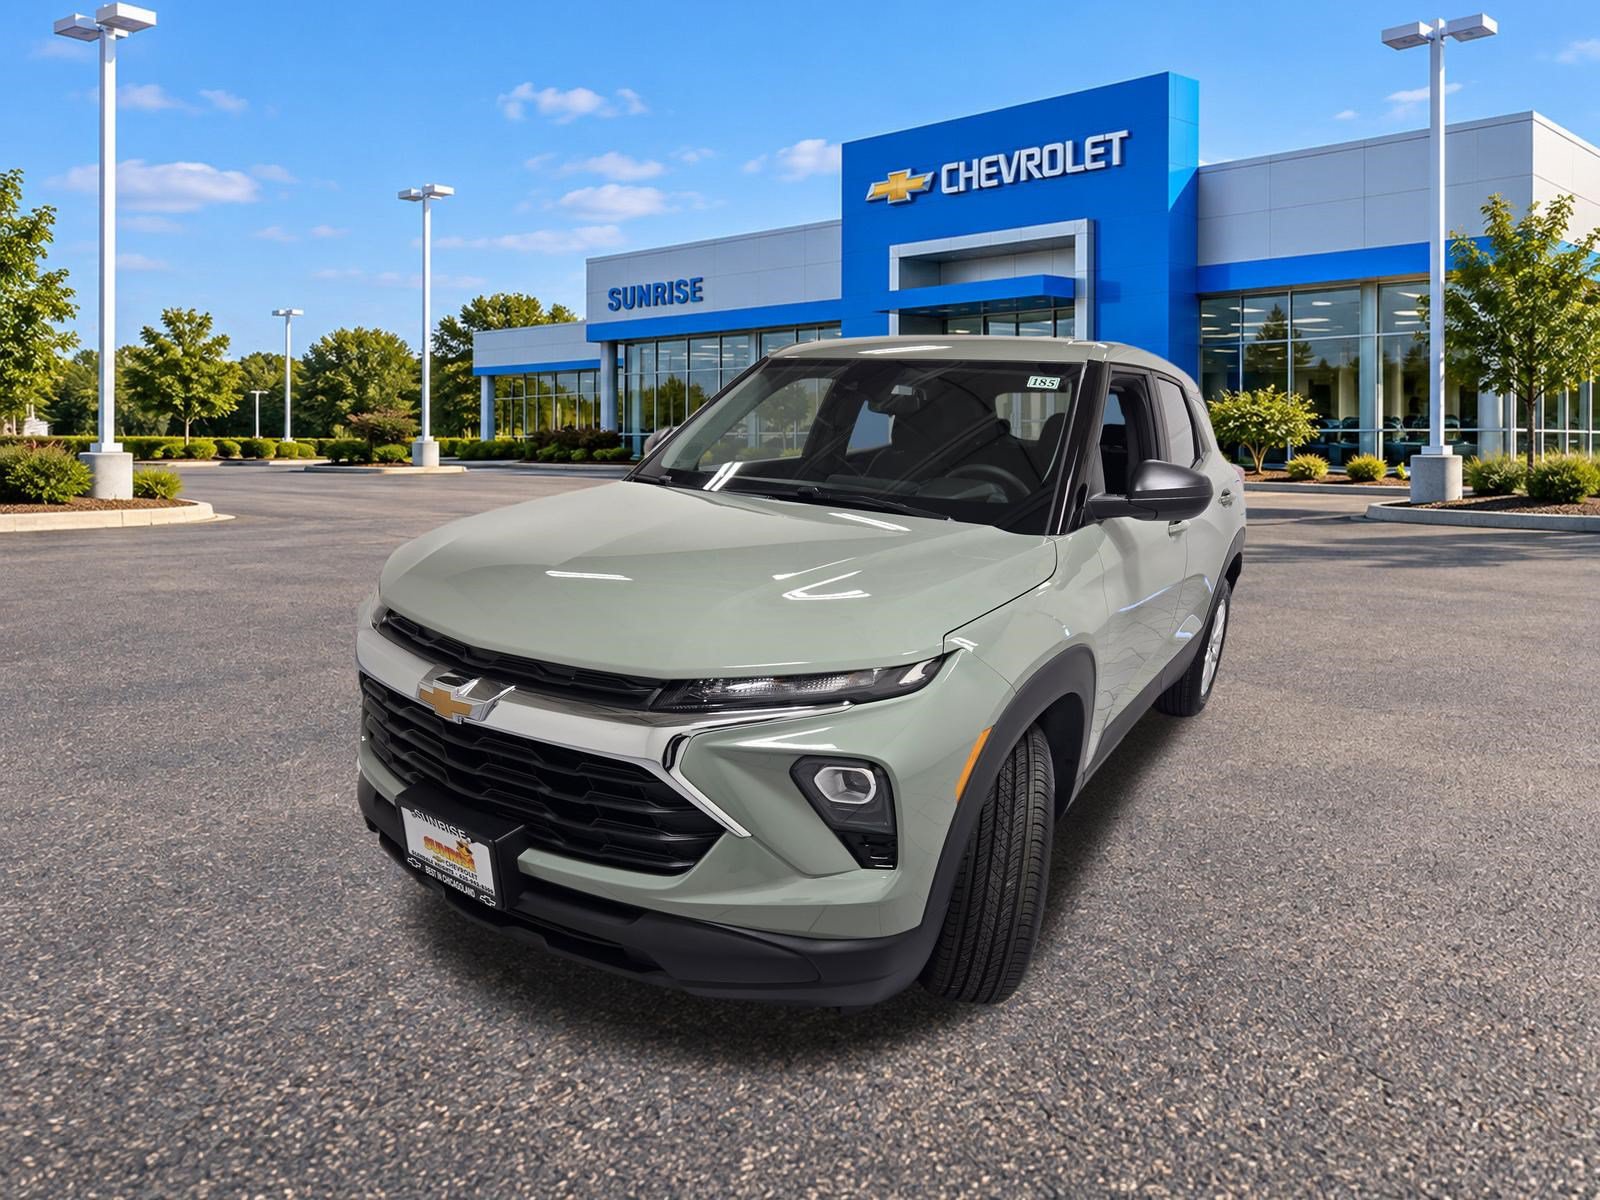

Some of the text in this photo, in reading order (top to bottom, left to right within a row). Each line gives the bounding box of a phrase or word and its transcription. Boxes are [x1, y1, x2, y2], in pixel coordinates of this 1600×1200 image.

[941, 130, 1129, 194] CHEVROLET
[608, 277, 703, 311] SUNRISE
[1032, 378, 1056, 387] 185
[413, 809, 466, 840] SUNRISE
[425, 865, 437, 878] BEST
[442, 874, 476, 897] CHICAGOLAND
[445, 860, 478, 880] CHEVROLET
